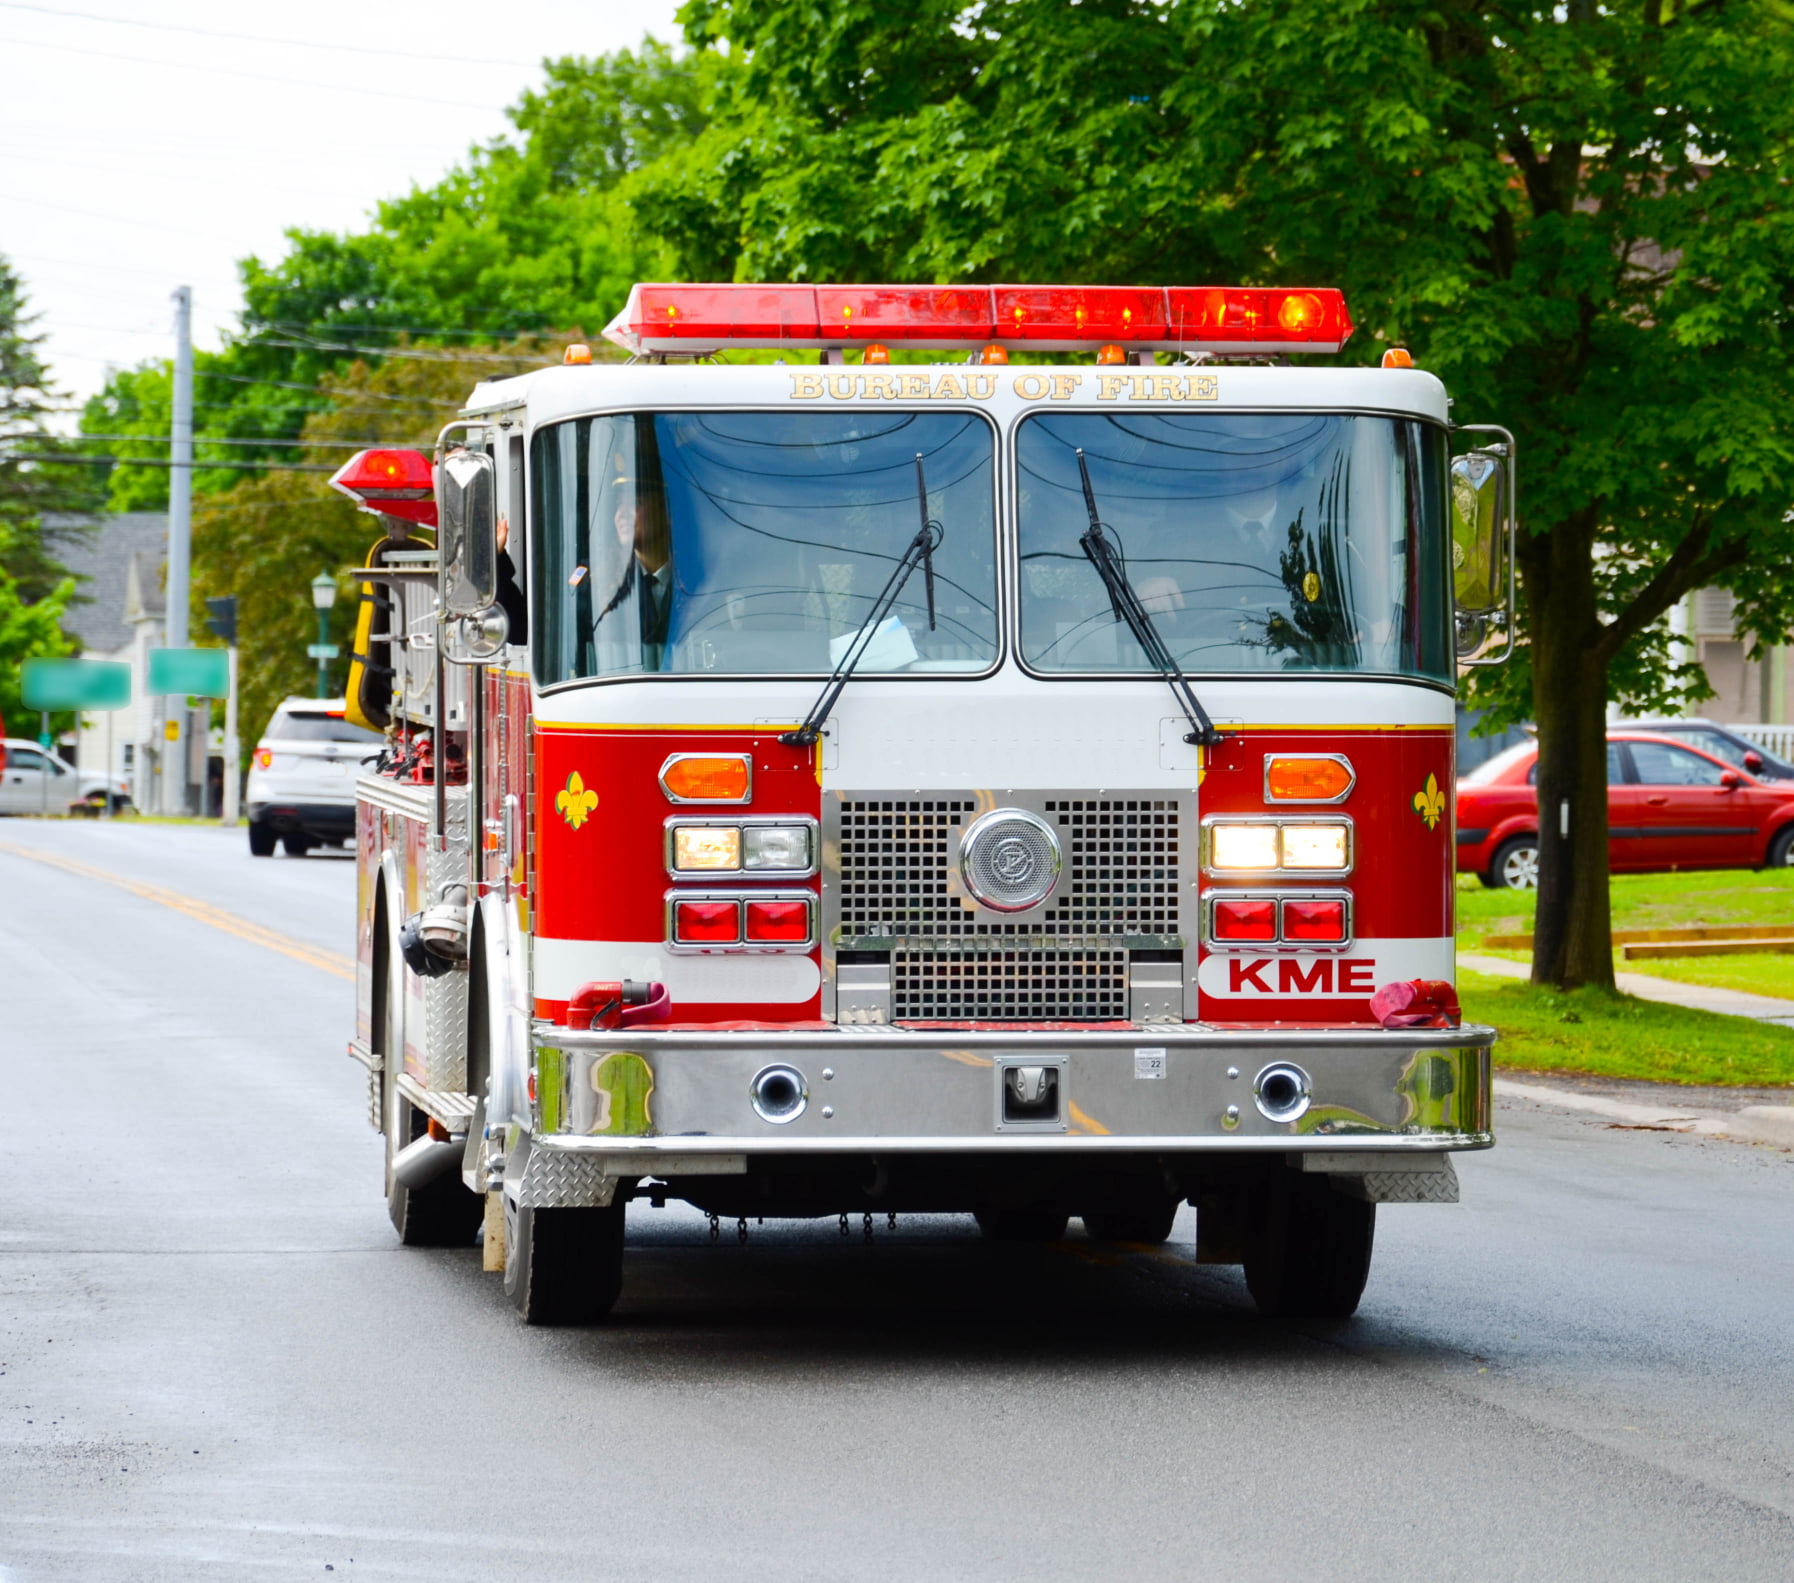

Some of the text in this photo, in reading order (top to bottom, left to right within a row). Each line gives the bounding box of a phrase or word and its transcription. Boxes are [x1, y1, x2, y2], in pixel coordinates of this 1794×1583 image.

[789, 373, 1219, 401] BUREAU OF FIRE
[1229, 958, 1376, 993] KME
[1150, 1060, 1161, 1068] 22
